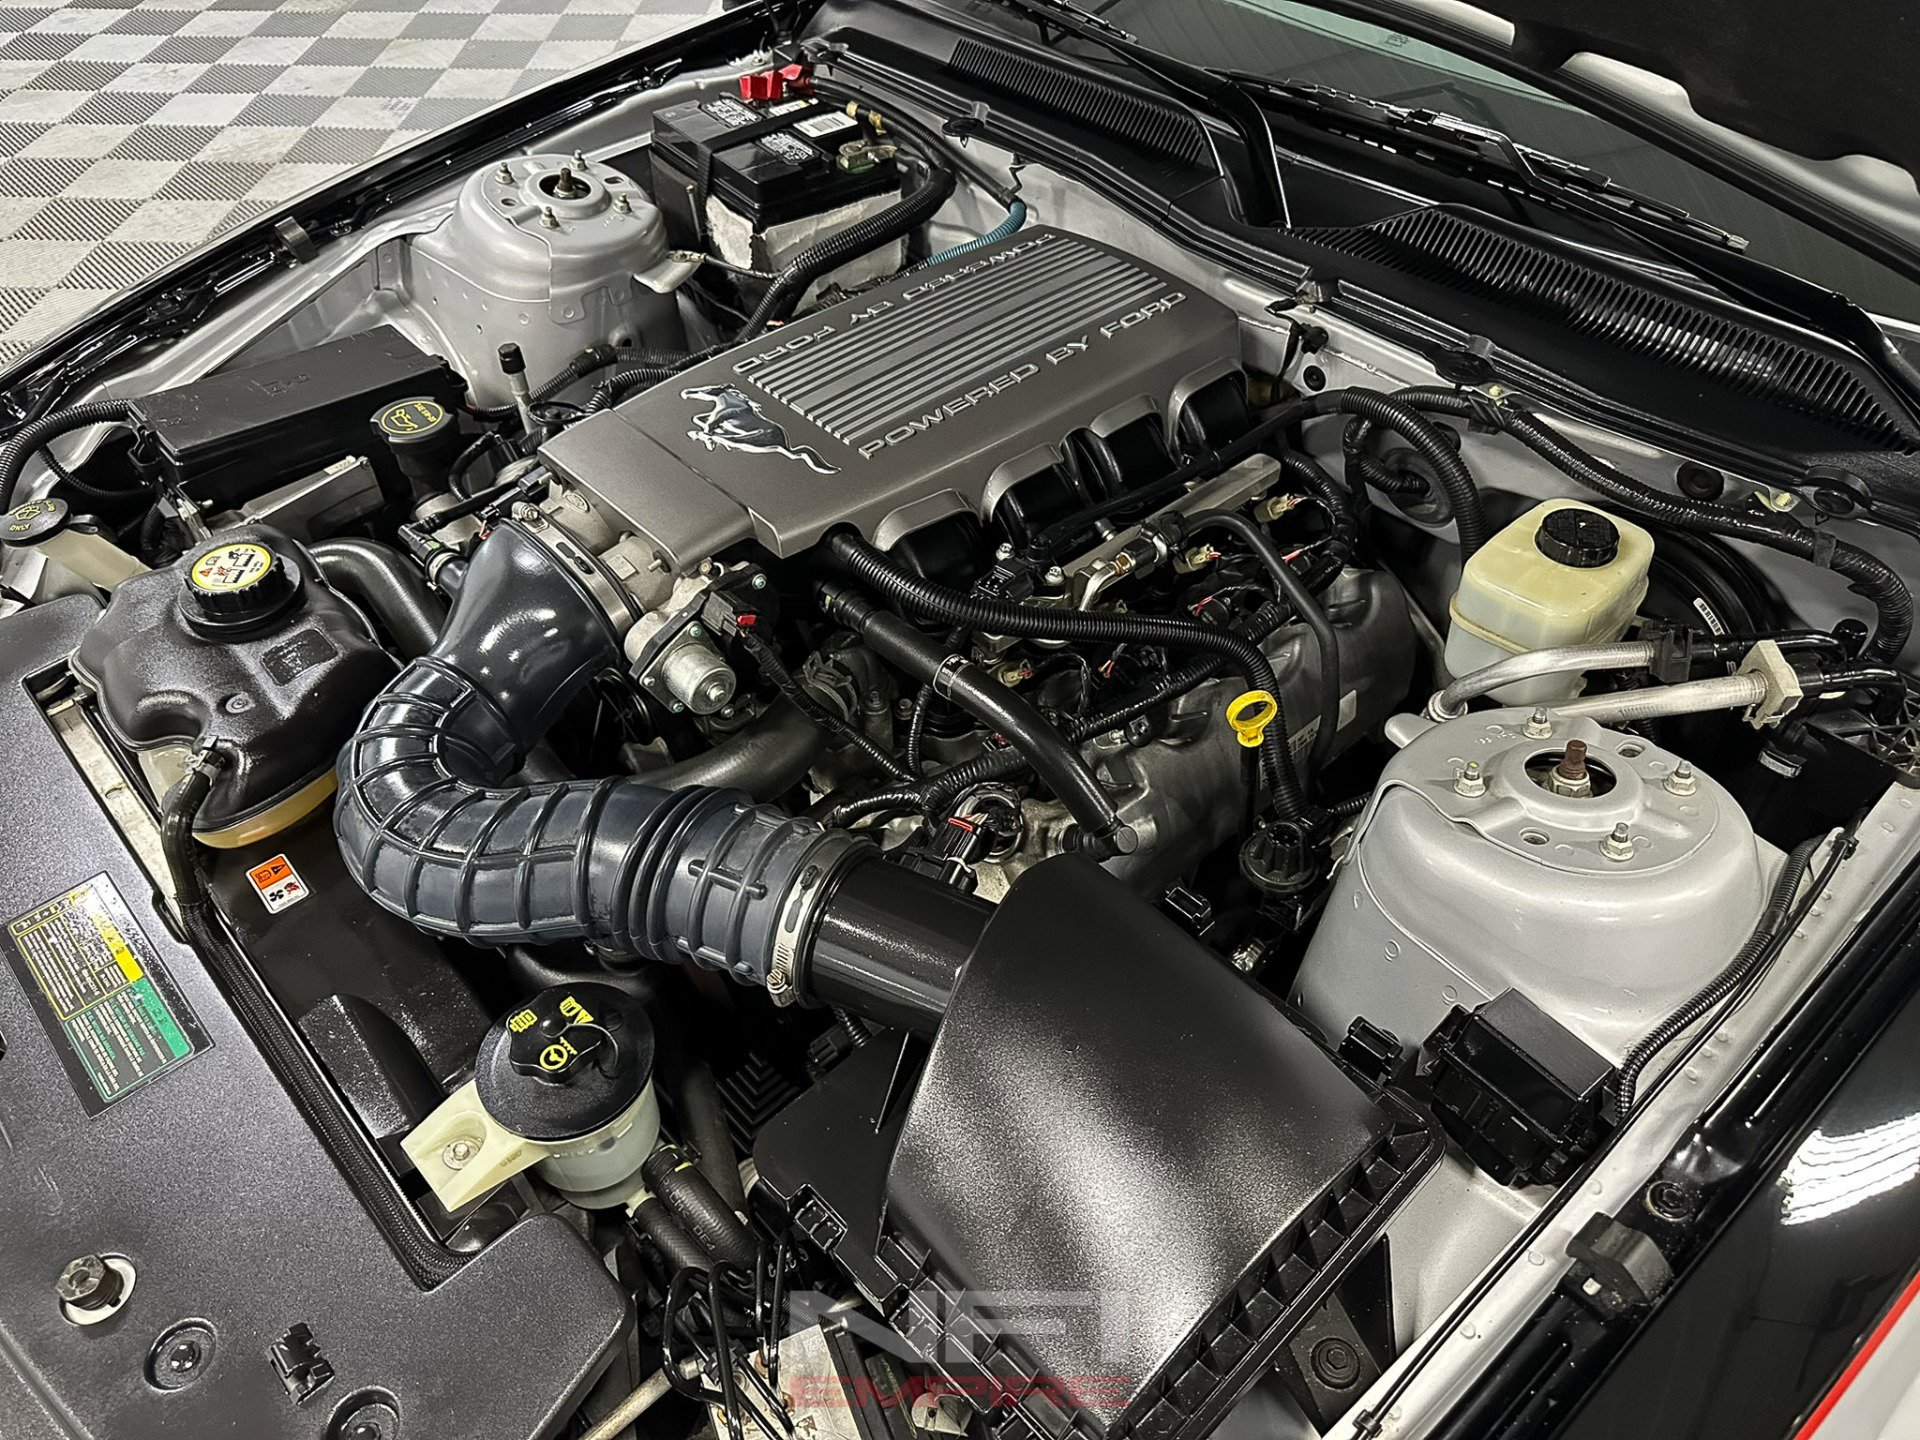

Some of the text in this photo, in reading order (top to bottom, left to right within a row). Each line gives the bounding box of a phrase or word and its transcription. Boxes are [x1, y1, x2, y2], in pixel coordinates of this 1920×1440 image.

[732, 233, 1055, 375] POWERED BY FORD
[858, 291, 1188, 460] POWERED BY FORD
[9, 524, 31, 532] ONLY
